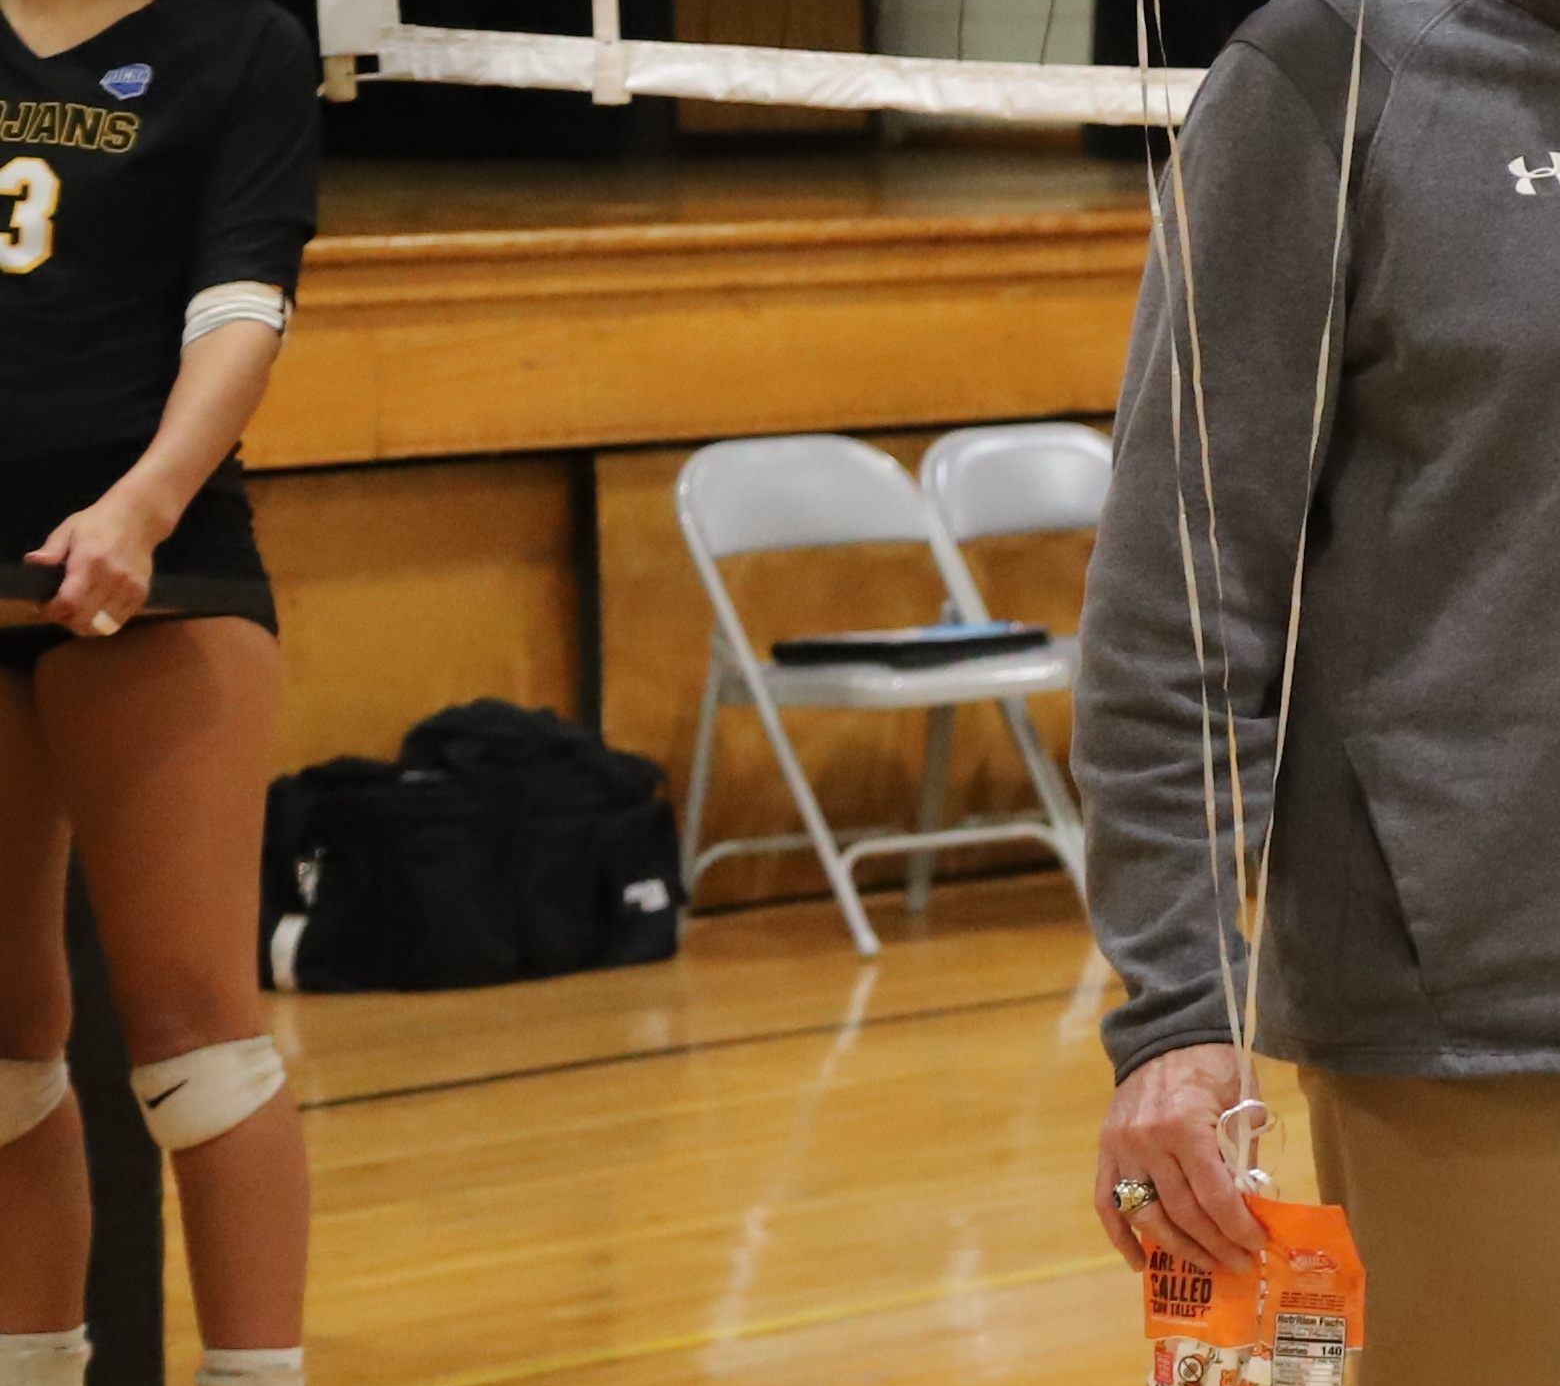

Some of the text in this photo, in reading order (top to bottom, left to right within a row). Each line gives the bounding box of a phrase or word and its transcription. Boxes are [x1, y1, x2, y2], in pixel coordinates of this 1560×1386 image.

[0, 100, 140, 154] JANS
[1150, 1272, 1213, 1305] CALLED
[1321, 1345, 1343, 1357] 140
